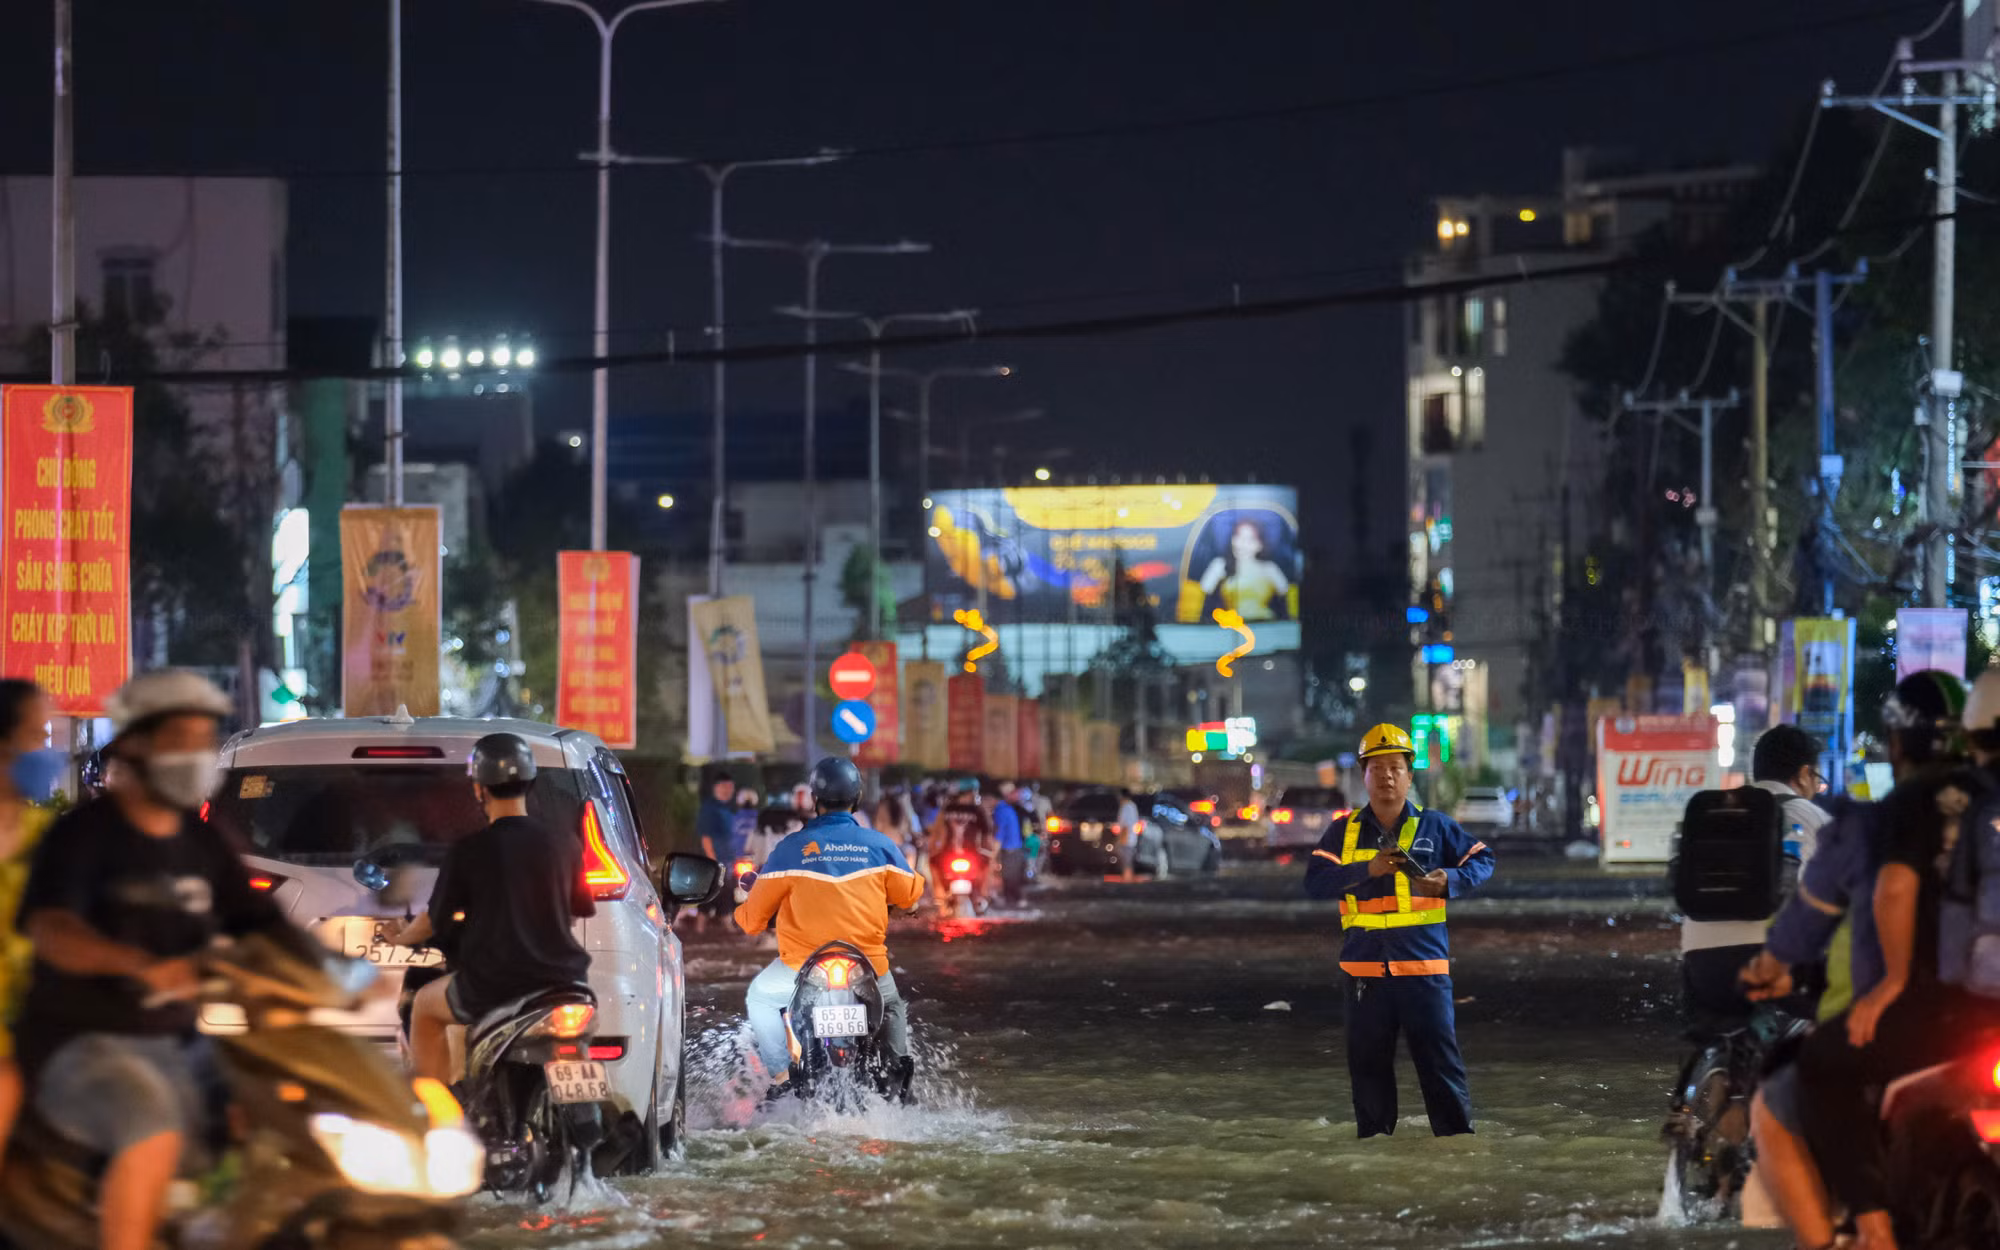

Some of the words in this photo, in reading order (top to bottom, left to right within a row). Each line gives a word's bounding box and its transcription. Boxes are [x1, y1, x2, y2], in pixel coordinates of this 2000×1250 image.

[63, 452, 97, 496] ĐỘNG
[15, 500, 57, 540] PHÒNG
[60, 504, 91, 541] CHÁY
[93, 500, 116, 545] TỐT,
[17, 549, 42, 592] SẴN
[80, 556, 113, 593] CHỮA
[12, 605, 44, 643] CHÁY
[46, 612, 68, 651] KỊP
[70, 607, 97, 645] THỜI
[100, 607, 116, 645] VÀ
[66, 656, 92, 700] QUẢ
[818, 855, 832, 863] CAO
[833, 855, 850, 863] GIAO
[824, 843, 869, 853] AhaMove
[818, 1021, 865, 1035] 369.66
